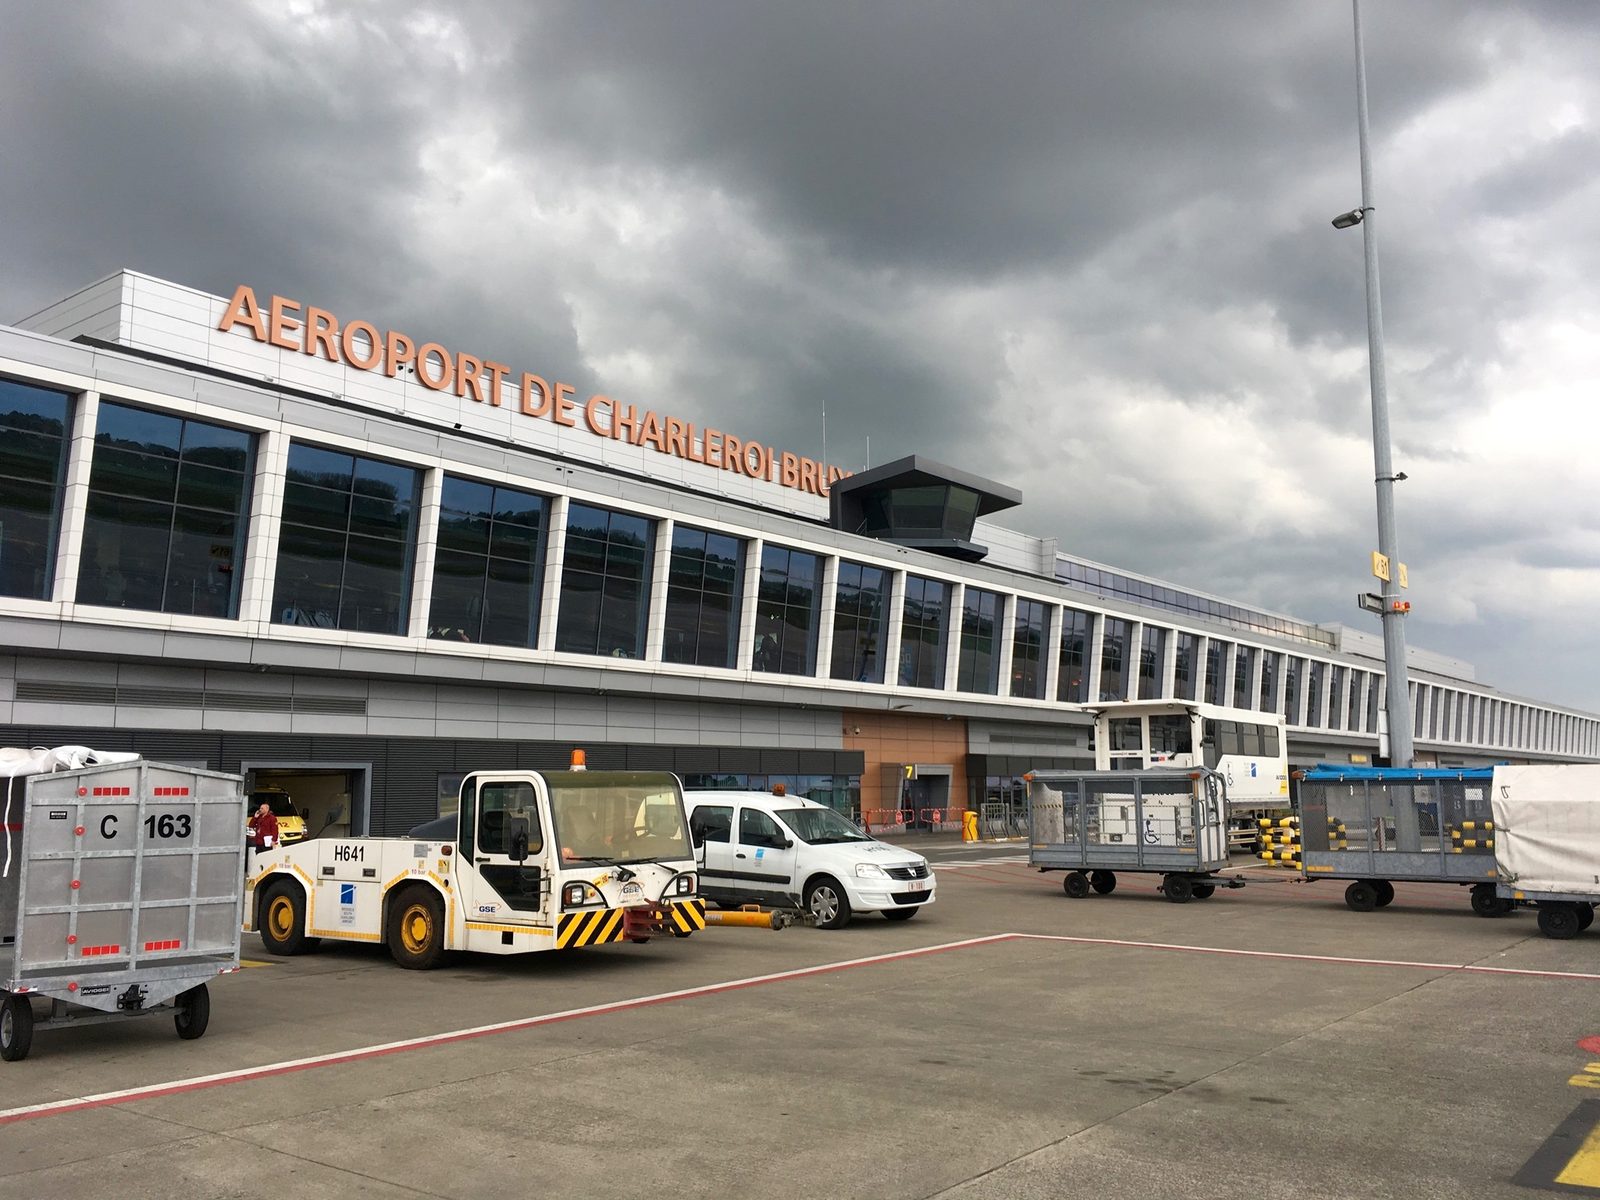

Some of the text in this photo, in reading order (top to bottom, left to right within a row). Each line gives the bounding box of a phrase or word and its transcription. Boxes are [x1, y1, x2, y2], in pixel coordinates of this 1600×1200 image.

[218, 284, 511, 407] AEROPORT
[521, 371, 576, 427] DE
[585, 394, 774, 482] CHARLEROI
[905, 765, 913, 779] 7
[100, 814, 192, 839] C 163
[334, 845, 364, 862] H641
[479, 905, 496, 913] GSE
